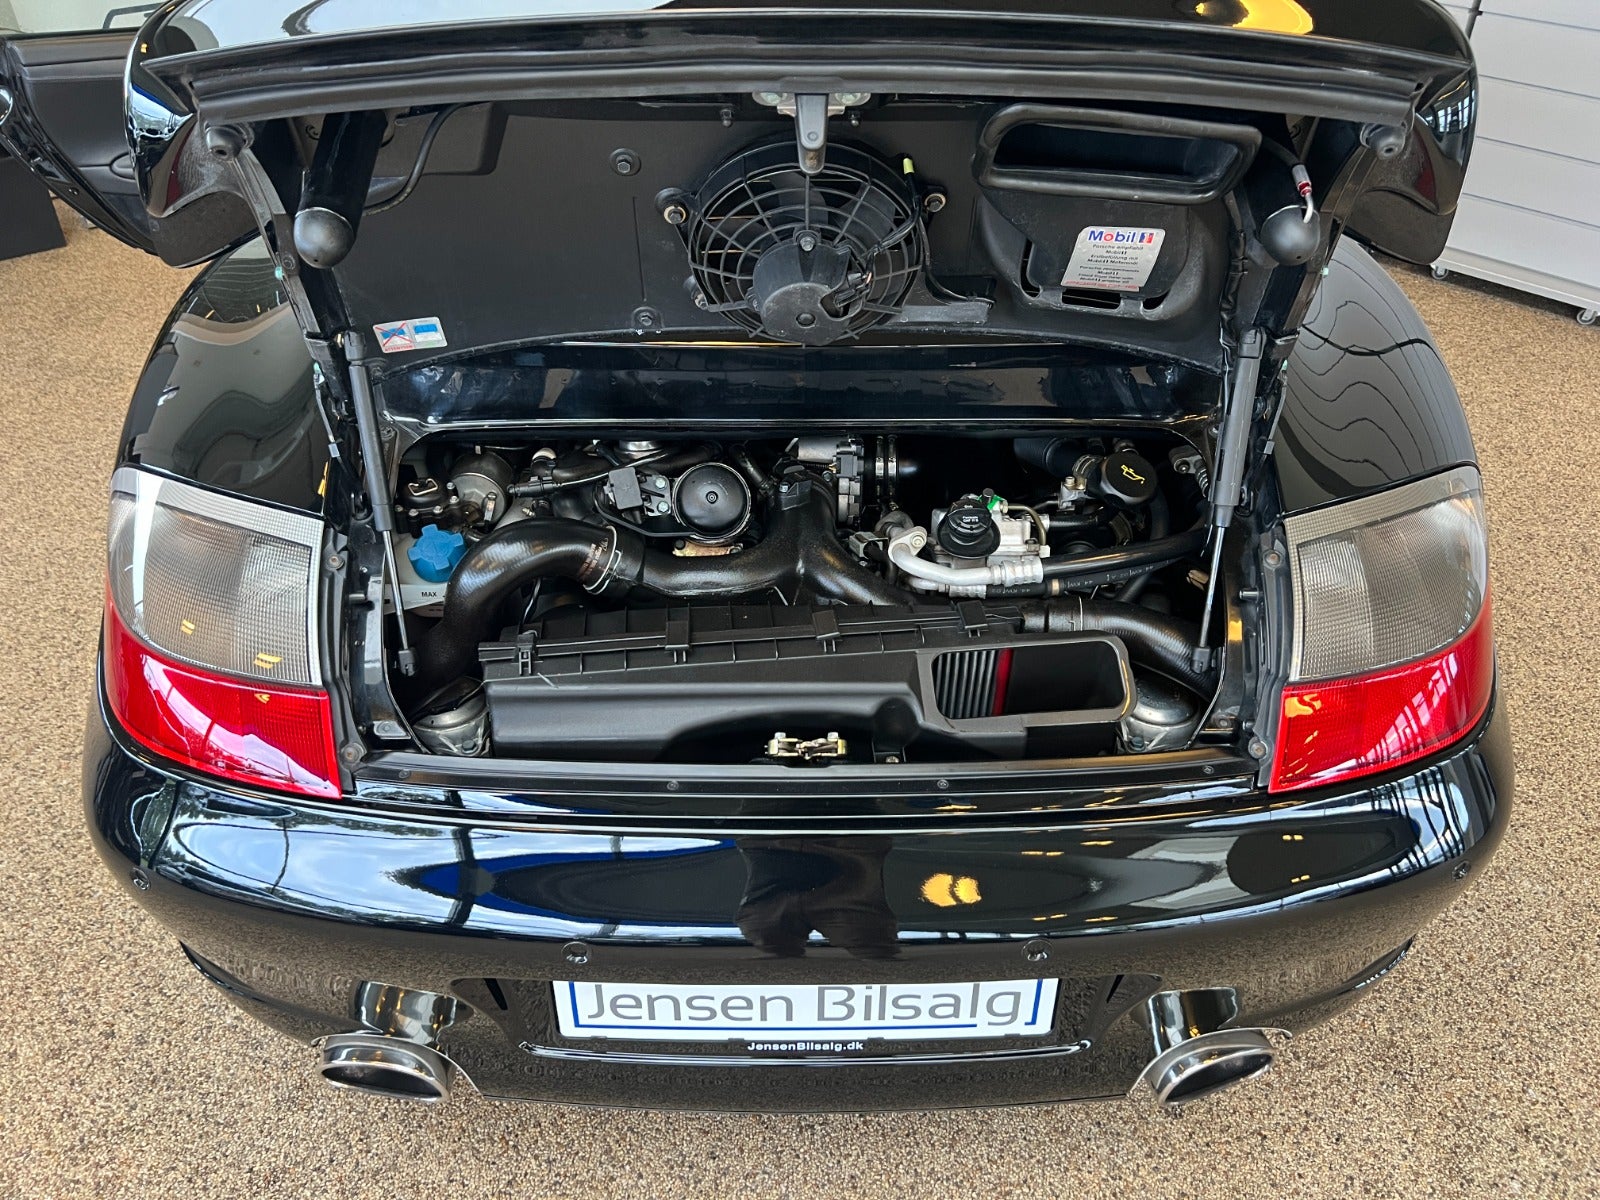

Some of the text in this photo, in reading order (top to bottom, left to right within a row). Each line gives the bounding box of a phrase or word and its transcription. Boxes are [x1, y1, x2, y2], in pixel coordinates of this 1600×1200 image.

[1088, 230, 1136, 242] Mobil
[588, 982, 1021, 1026] Jensen Bilsalg
[747, 1041, 864, 1052] JensenBilsalg.dk
